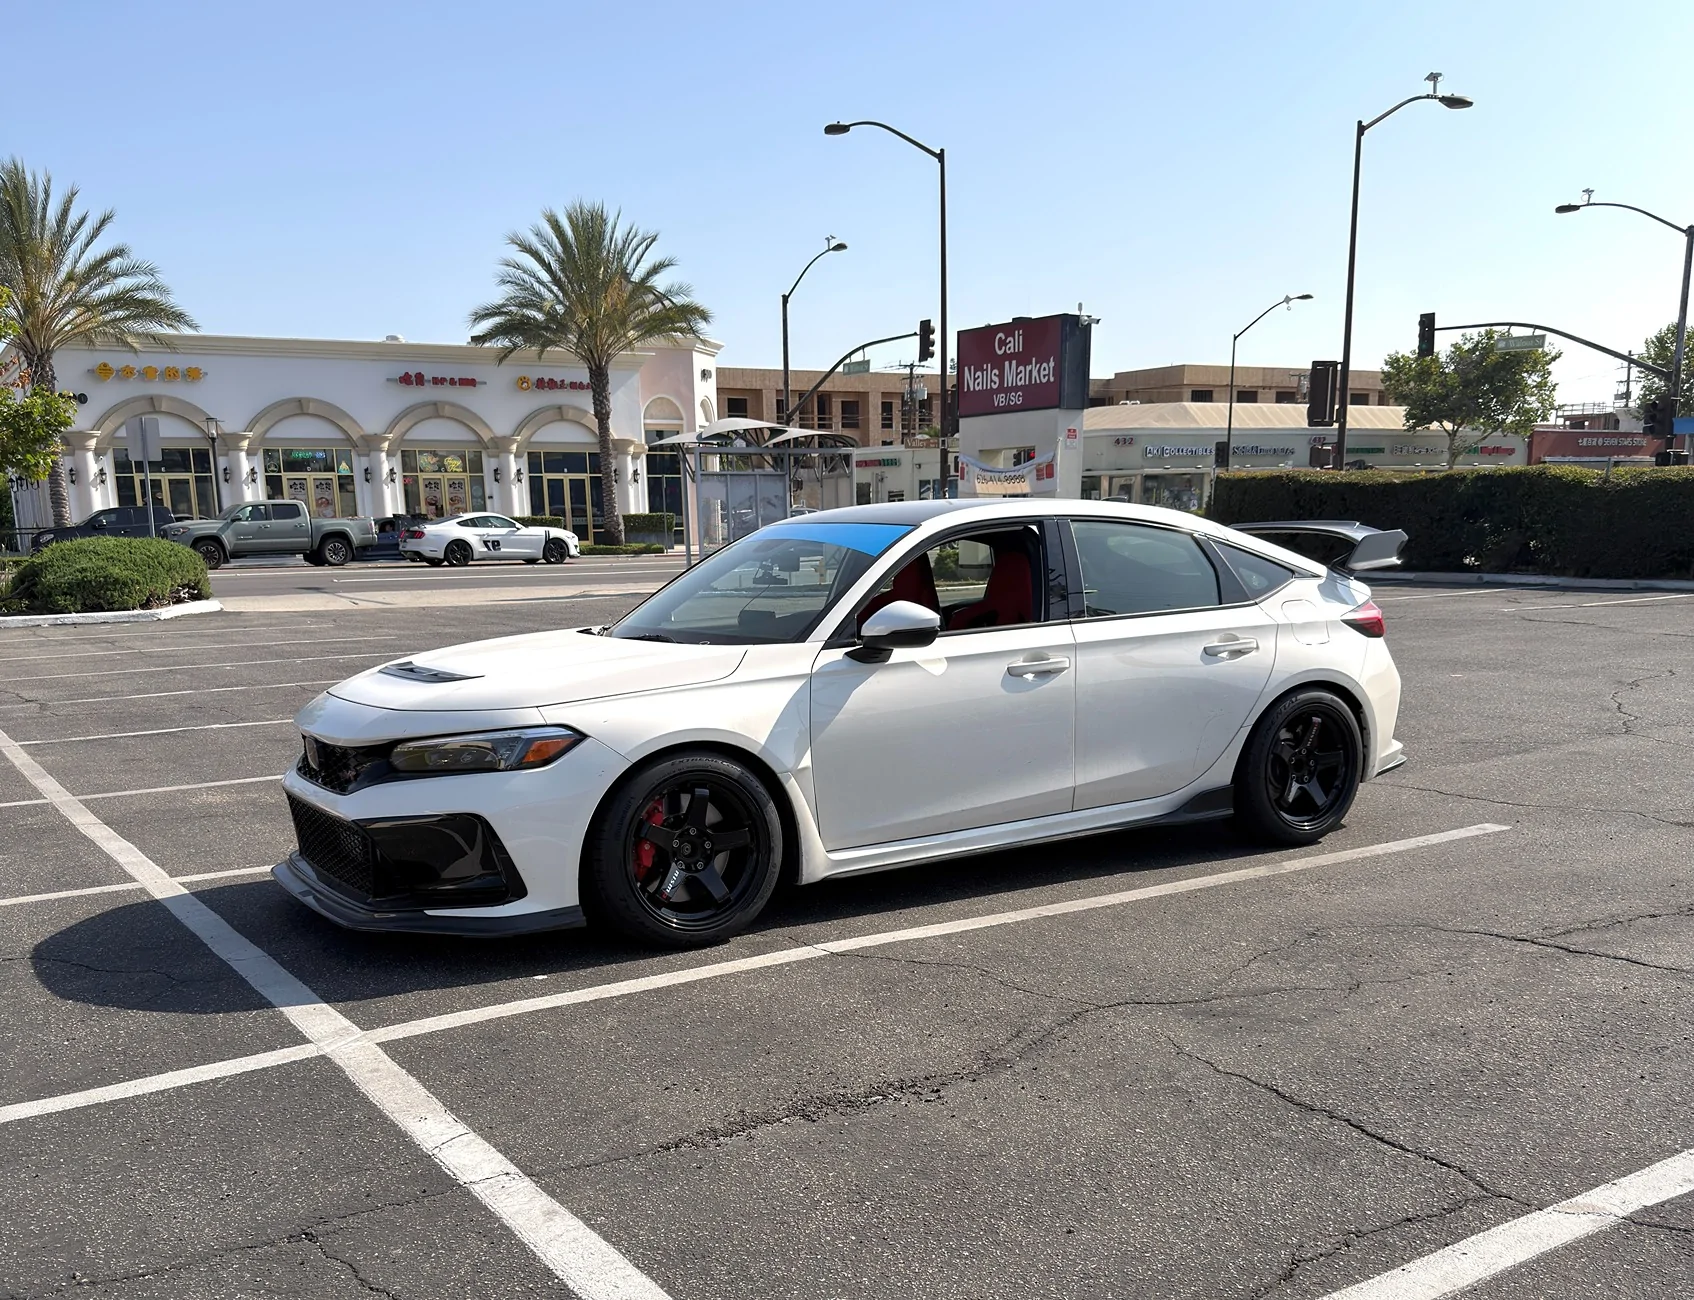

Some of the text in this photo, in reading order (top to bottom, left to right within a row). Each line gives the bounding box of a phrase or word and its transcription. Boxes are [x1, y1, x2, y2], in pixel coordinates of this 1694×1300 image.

[994, 330, 1023, 355] Cali
[964, 356, 1055, 392] Nails Market
[993, 391, 1023, 407] VB/SG
[907, 439, 926, 449] Valley
[1114, 437, 1134, 446] 432
[1163, 446, 1215, 458] COLLECTIBLES
